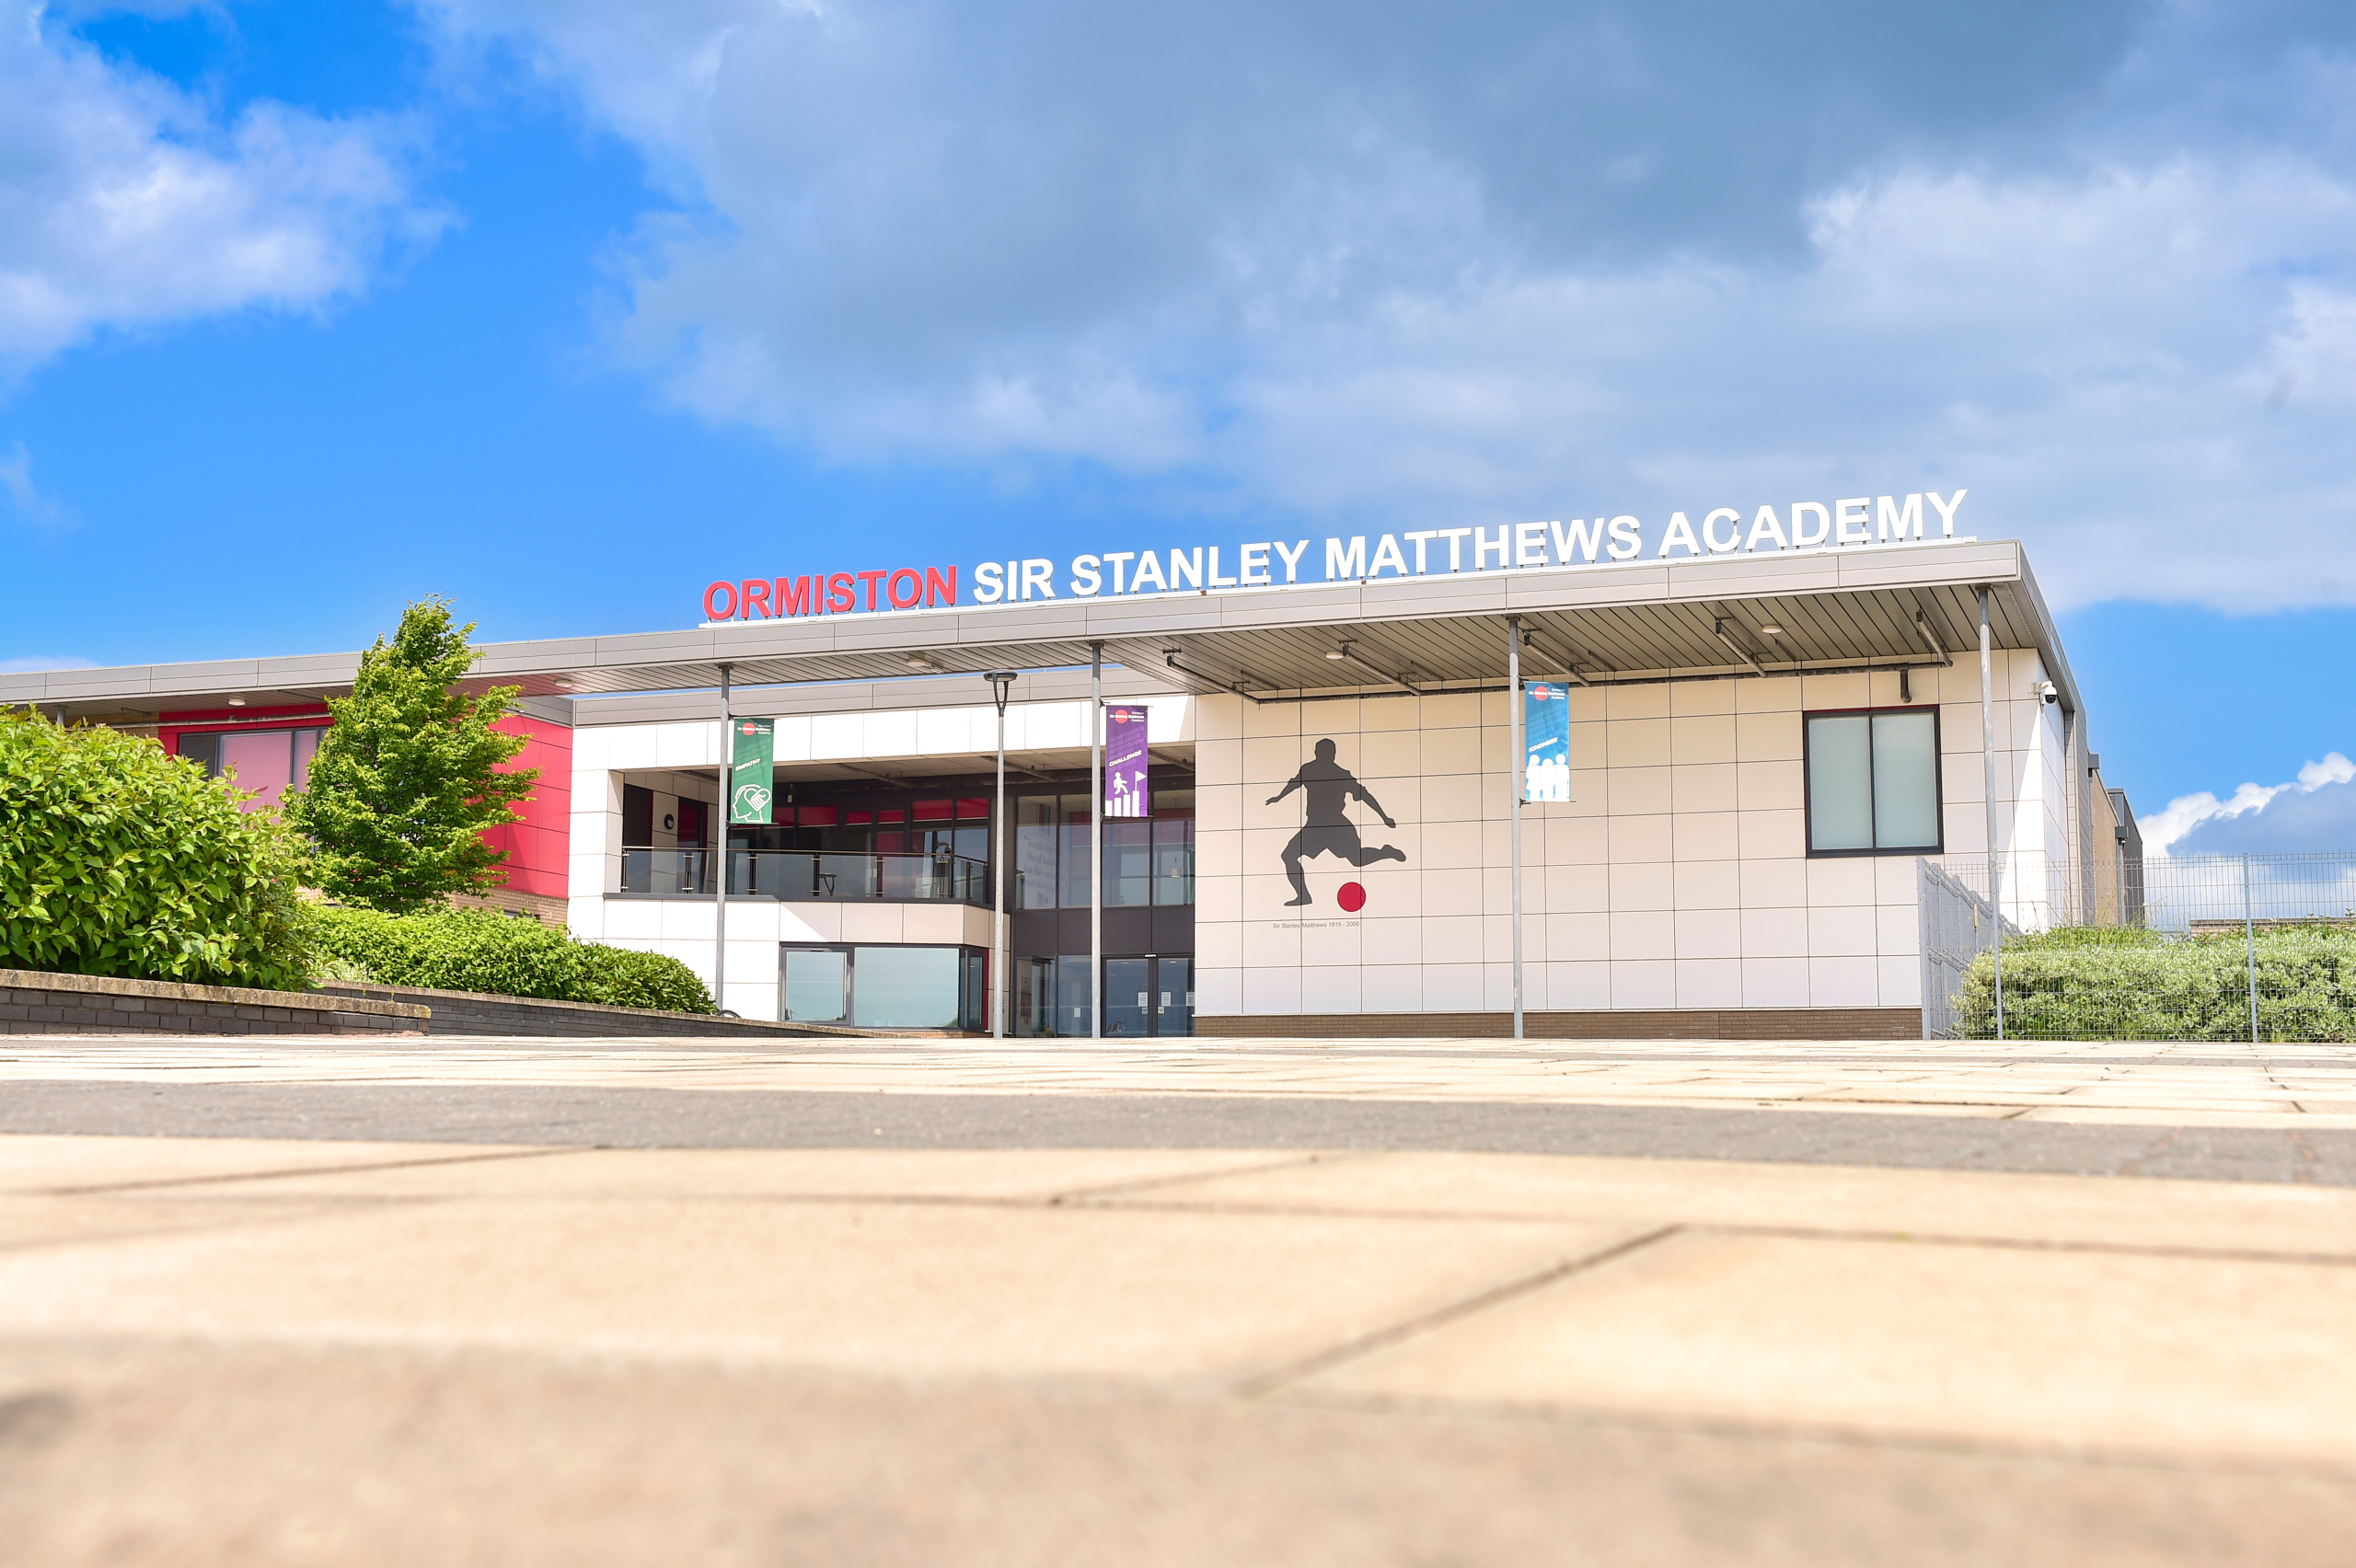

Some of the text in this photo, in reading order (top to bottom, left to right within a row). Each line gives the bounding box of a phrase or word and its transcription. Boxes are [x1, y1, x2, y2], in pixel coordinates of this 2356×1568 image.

[703, 489, 1969, 620] ORMISTON SIR STANLEY MATTHEWS ACADEMY
[1529, 736, 1558, 754] KINDNESS
[735, 757, 761, 771] EMPATHY
[1108, 749, 1142, 767] CHALLENGE
